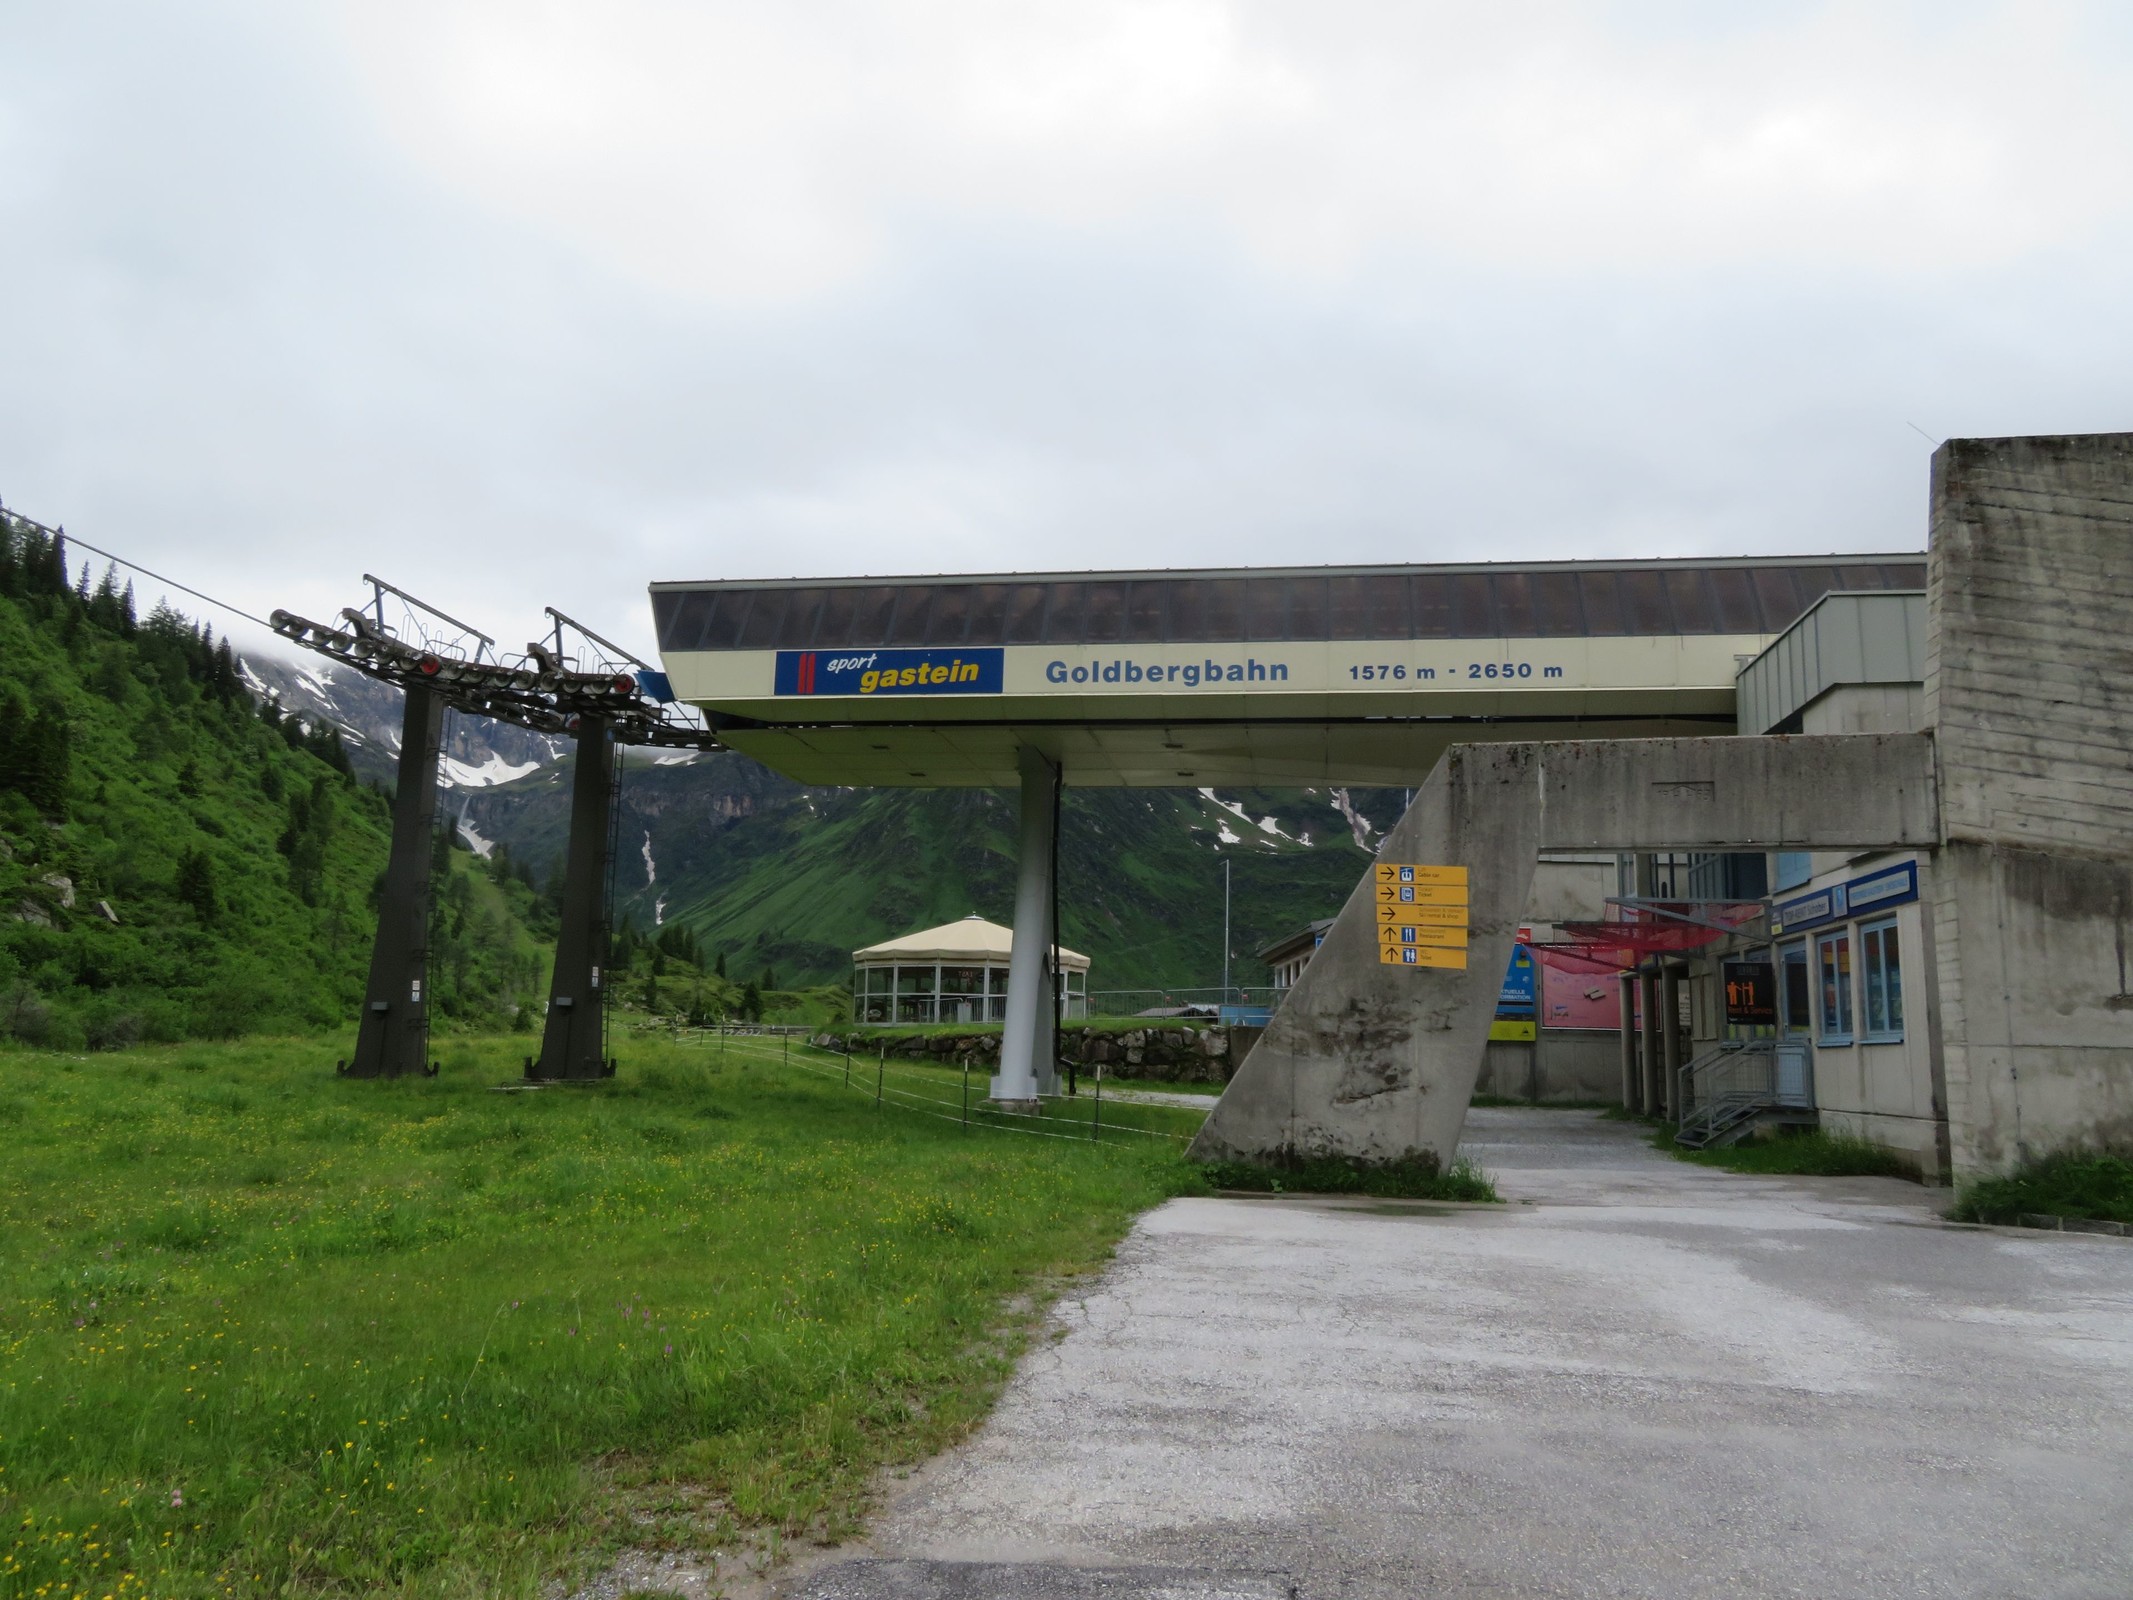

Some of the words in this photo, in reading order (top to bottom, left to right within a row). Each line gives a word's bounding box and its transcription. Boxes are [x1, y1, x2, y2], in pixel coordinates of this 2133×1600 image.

[826, 653, 878, 674] sport
[1045, 659, 1289, 687] Goldbergbahn
[1349, 665, 1407, 680] 1576
[1416, 667, 1436, 679] m
[1468, 663, 1532, 679] 2650
[1543, 666, 1564, 678] m
[859, 659, 979, 693] gastein
